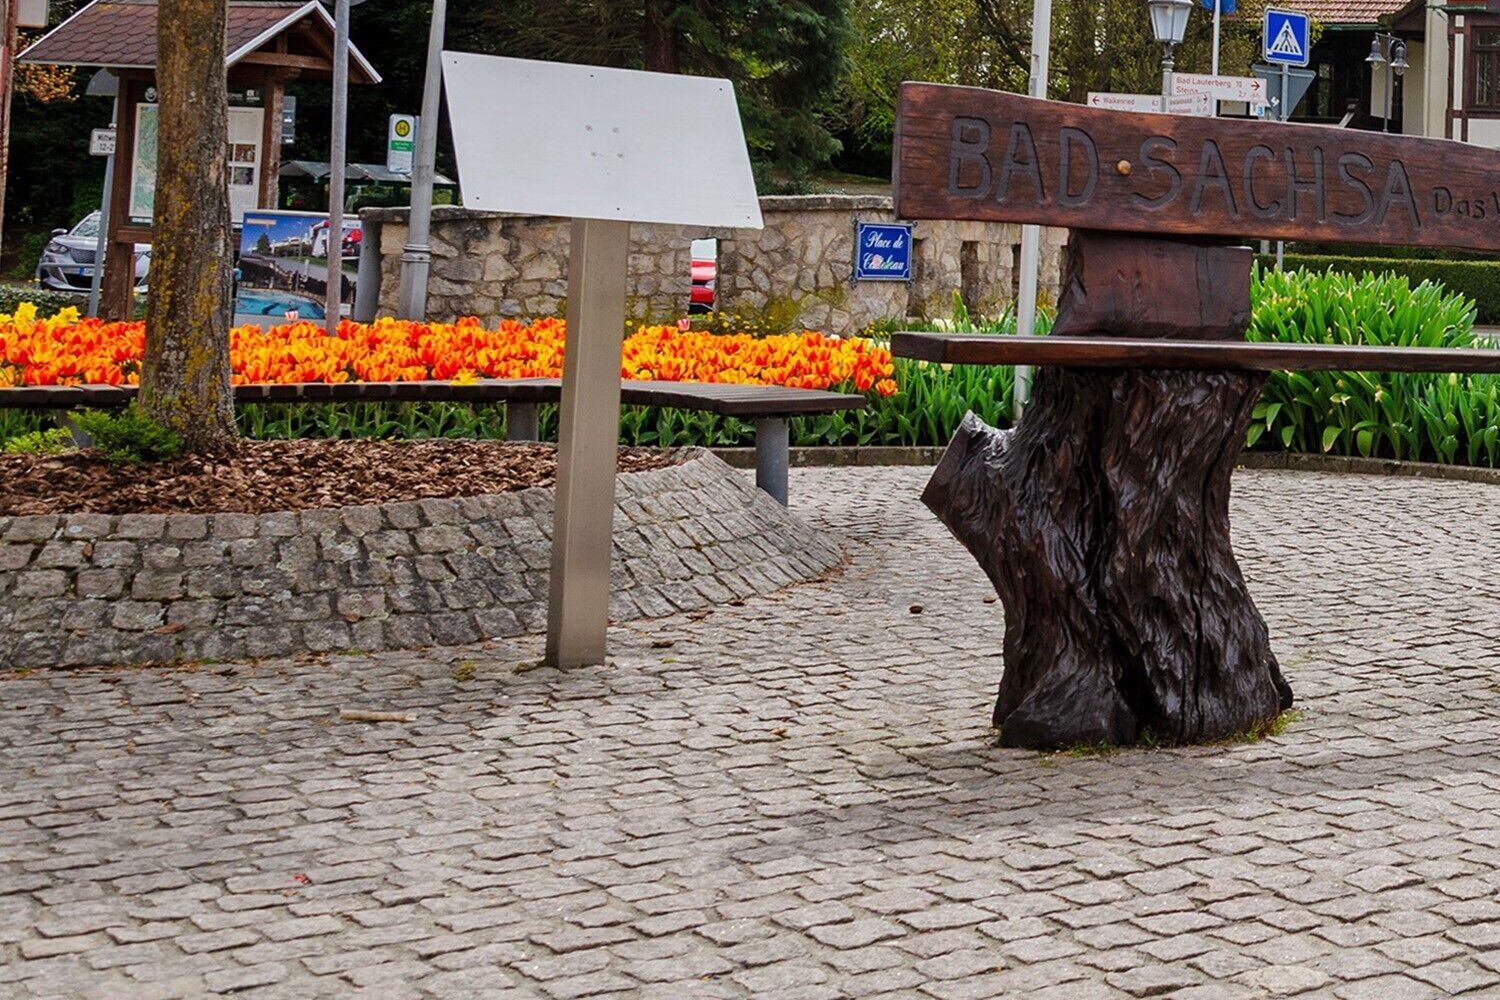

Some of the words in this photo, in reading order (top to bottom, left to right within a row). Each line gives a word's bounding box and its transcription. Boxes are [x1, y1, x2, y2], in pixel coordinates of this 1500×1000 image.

[1176, 76, 1192, 85] Bad
[1192, 78, 1232, 89] Lauterberg
[949, 115, 1100, 207] BAD
[1131, 134, 1422, 231] SACHSA
[1432, 186, 1486, 220] Das
[865, 230, 891, 248] Place
[893, 234, 904, 248] de
